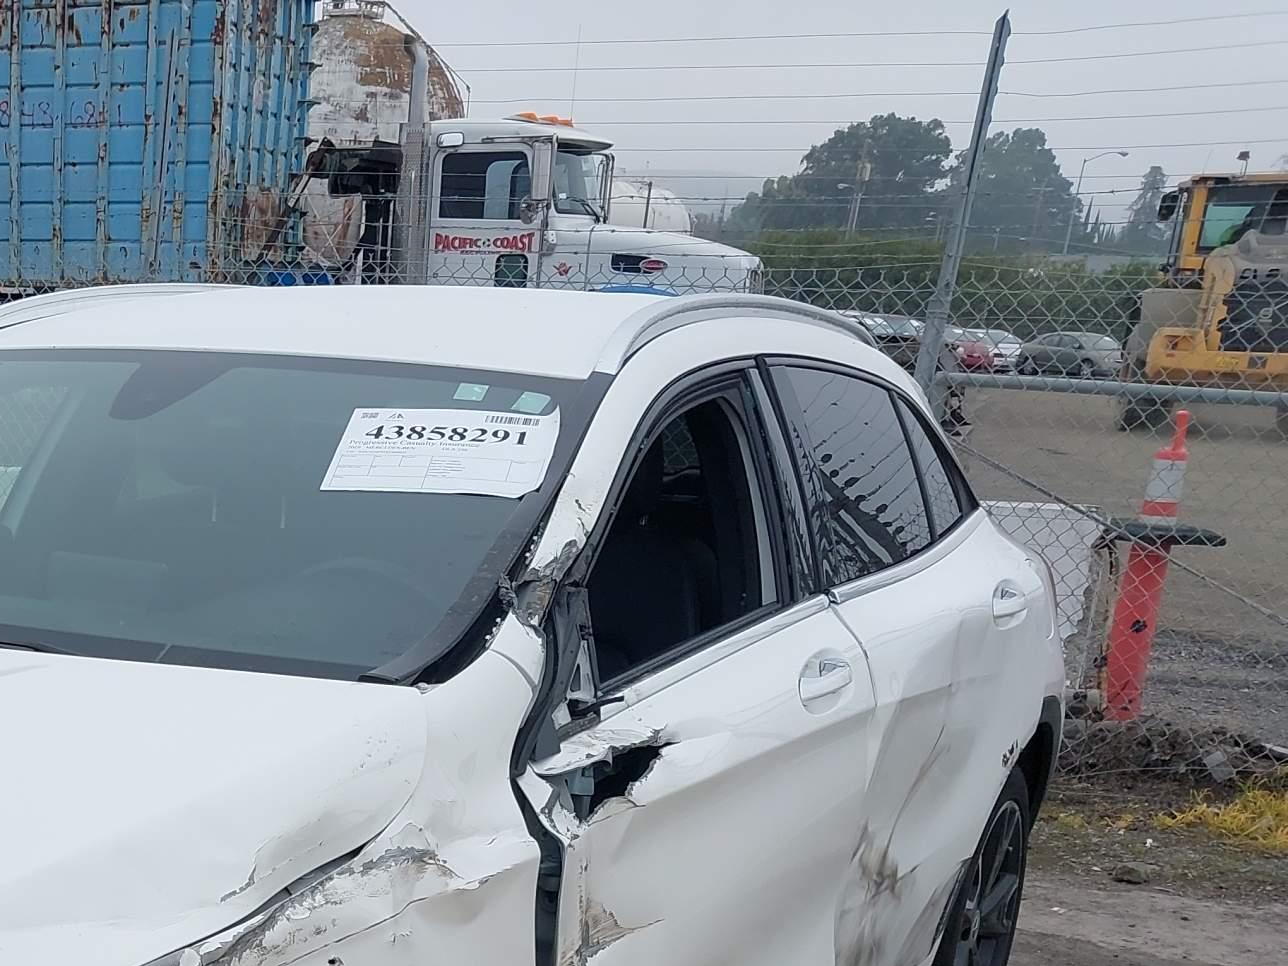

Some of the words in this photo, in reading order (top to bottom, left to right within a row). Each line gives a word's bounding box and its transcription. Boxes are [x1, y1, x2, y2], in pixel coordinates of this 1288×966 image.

[434, 232, 482, 251] PACIFIC
[492, 231, 536, 253] COAST
[365, 424, 528, 447] 43858291
